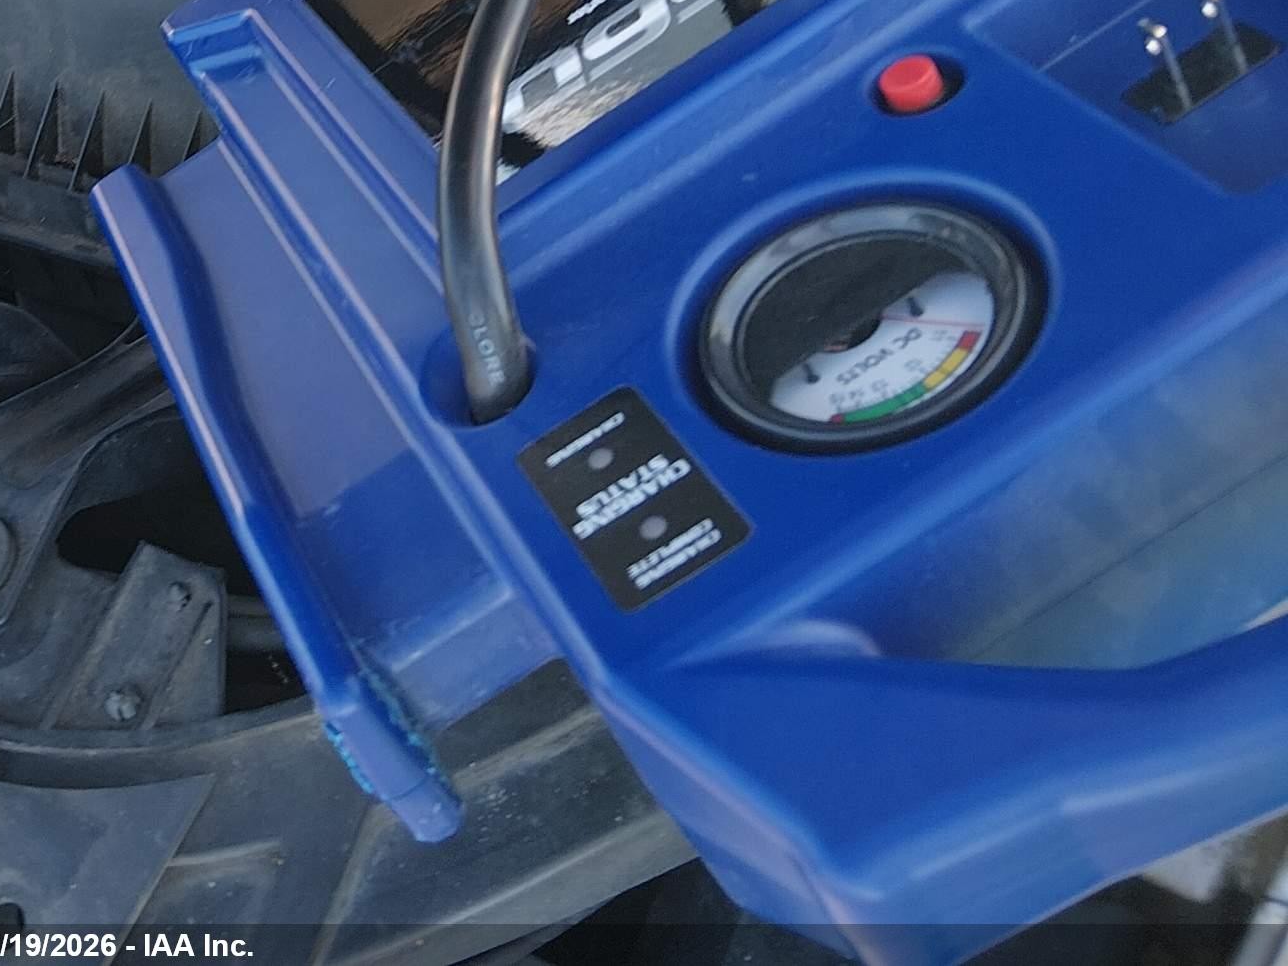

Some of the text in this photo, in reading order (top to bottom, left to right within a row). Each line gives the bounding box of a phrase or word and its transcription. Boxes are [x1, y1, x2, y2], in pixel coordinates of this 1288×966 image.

[837, 348, 895, 386] VOLTS
[572, 457, 692, 541] CHARGING
[575, 454, 670, 518] STATUS
